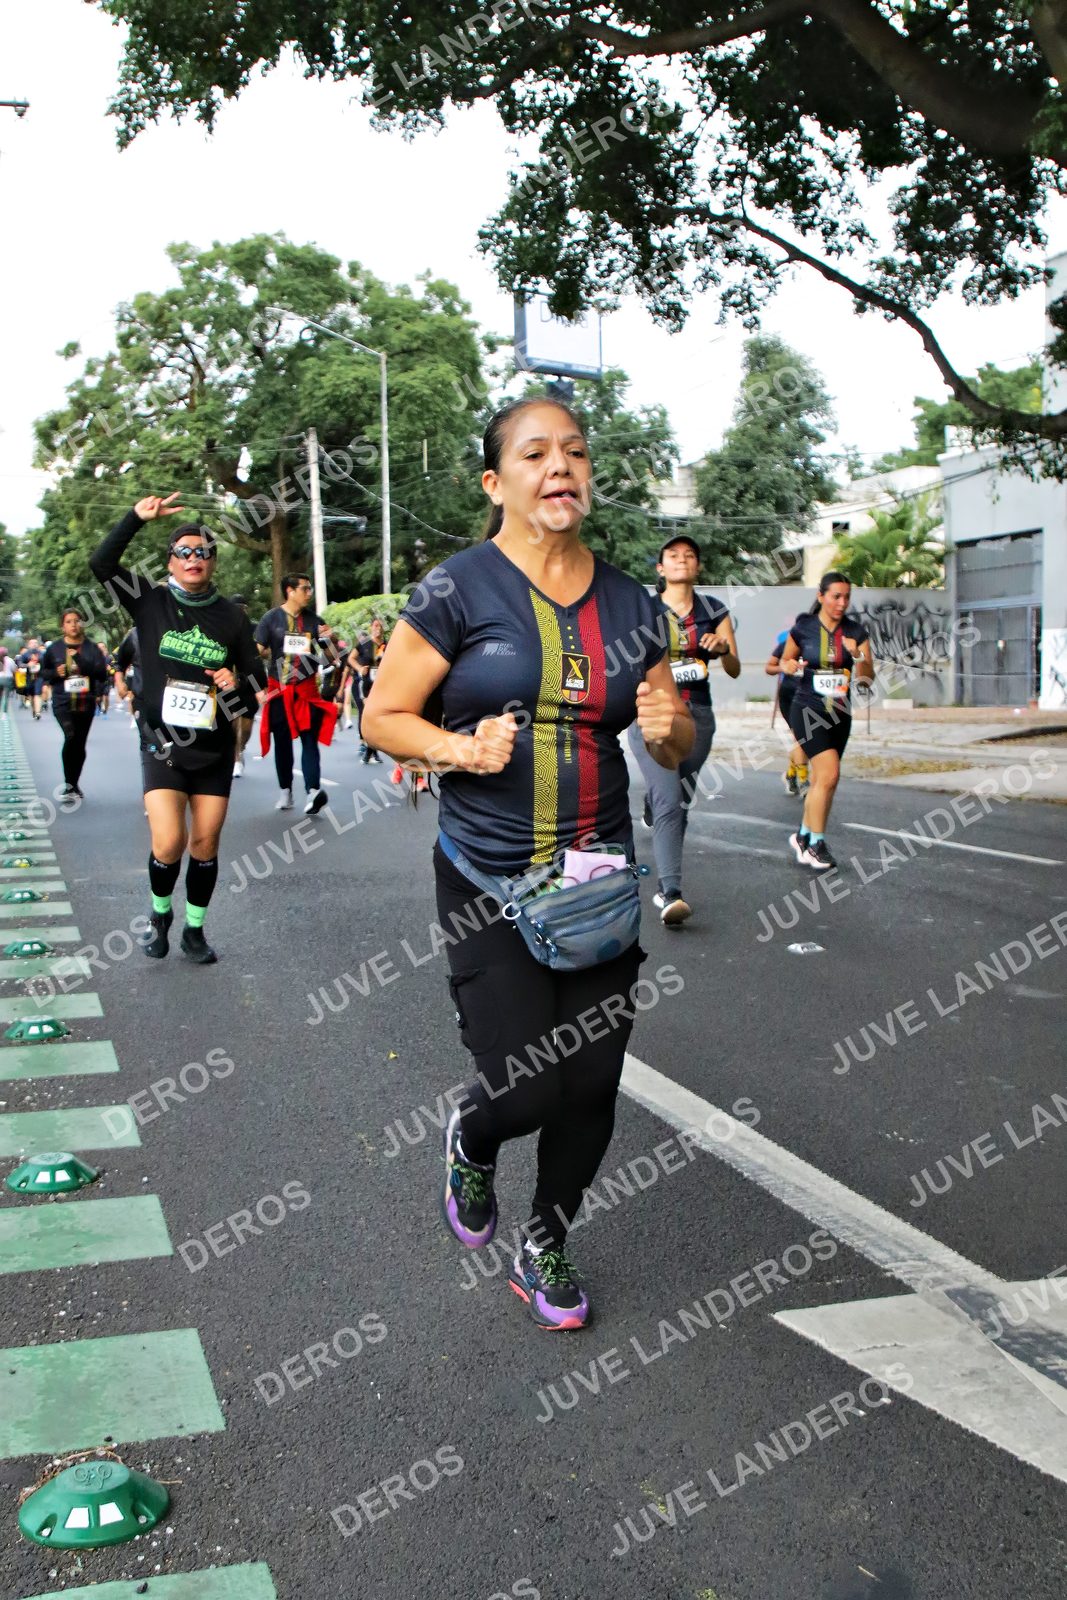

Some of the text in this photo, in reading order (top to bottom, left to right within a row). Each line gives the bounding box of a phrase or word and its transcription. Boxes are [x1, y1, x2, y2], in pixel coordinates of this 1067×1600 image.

[163, 635, 226, 662] GREEN TEAM
[170, 694, 207, 713] 3257
